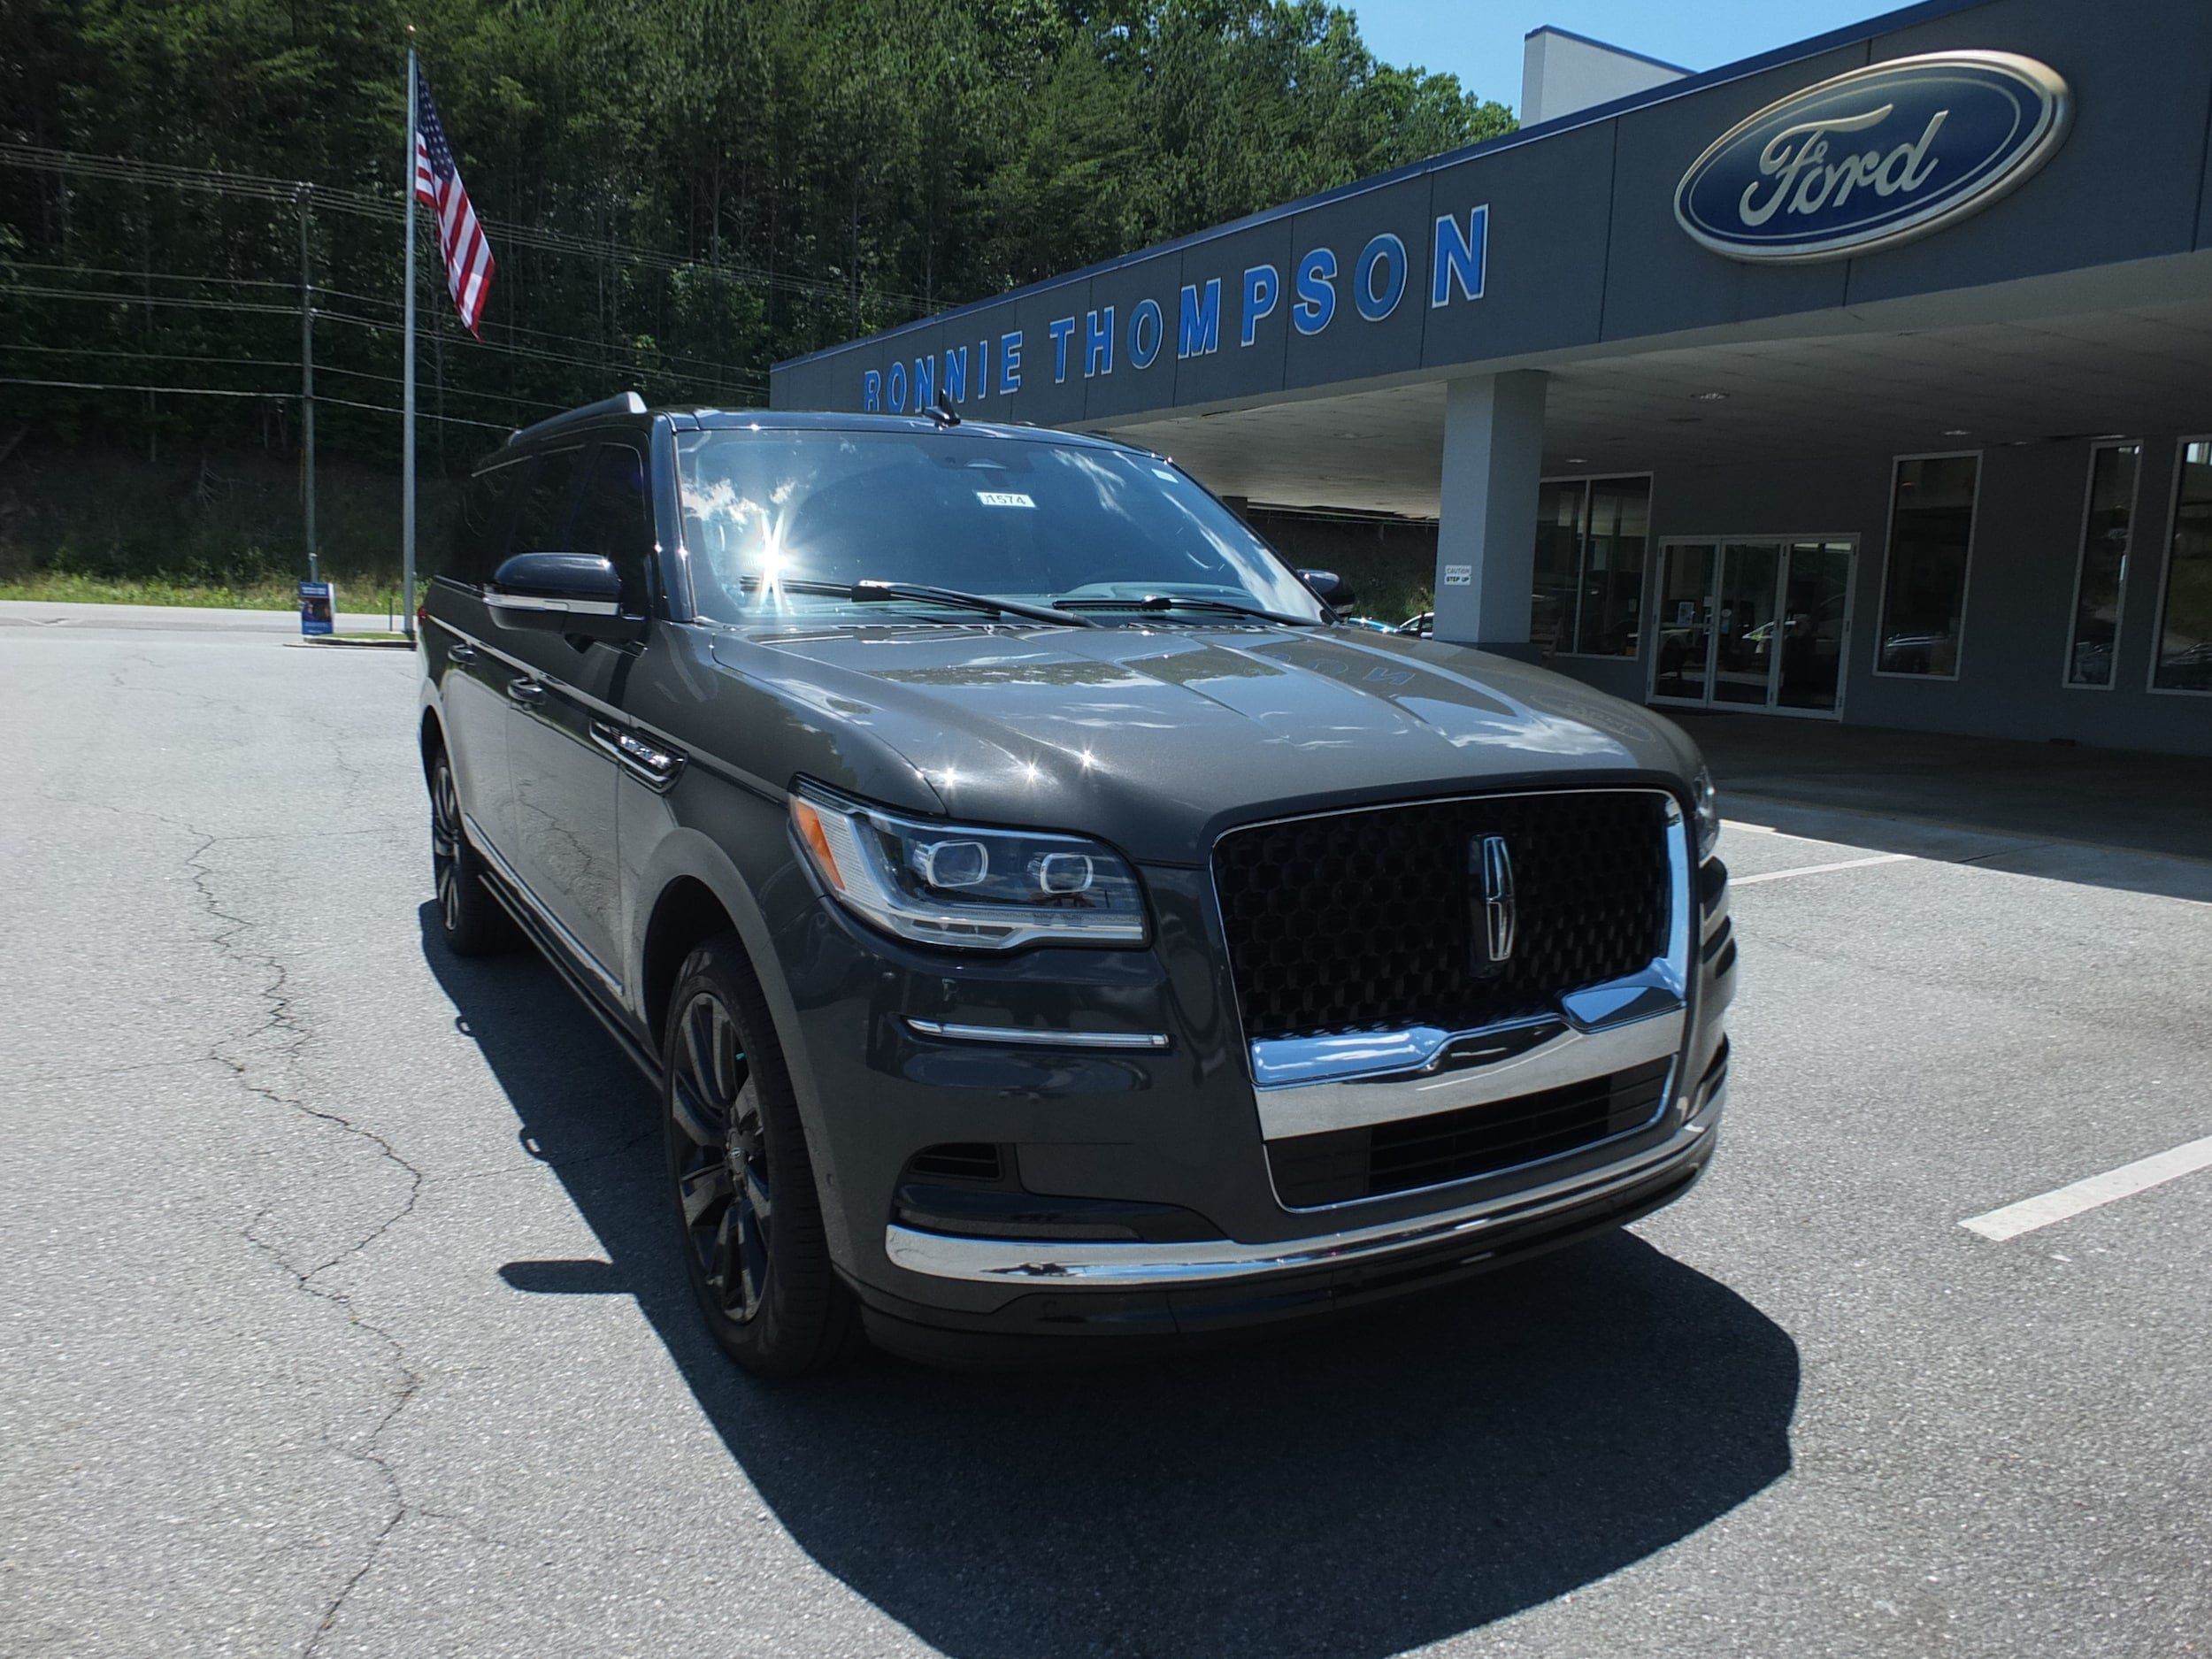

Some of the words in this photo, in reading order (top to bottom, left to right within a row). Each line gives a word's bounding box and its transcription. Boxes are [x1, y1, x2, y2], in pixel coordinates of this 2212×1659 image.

[1739, 104, 1948, 227] Ford
[864, 330, 1023, 413] RONNIE
[1049, 204, 1490, 384] THOMPSON
